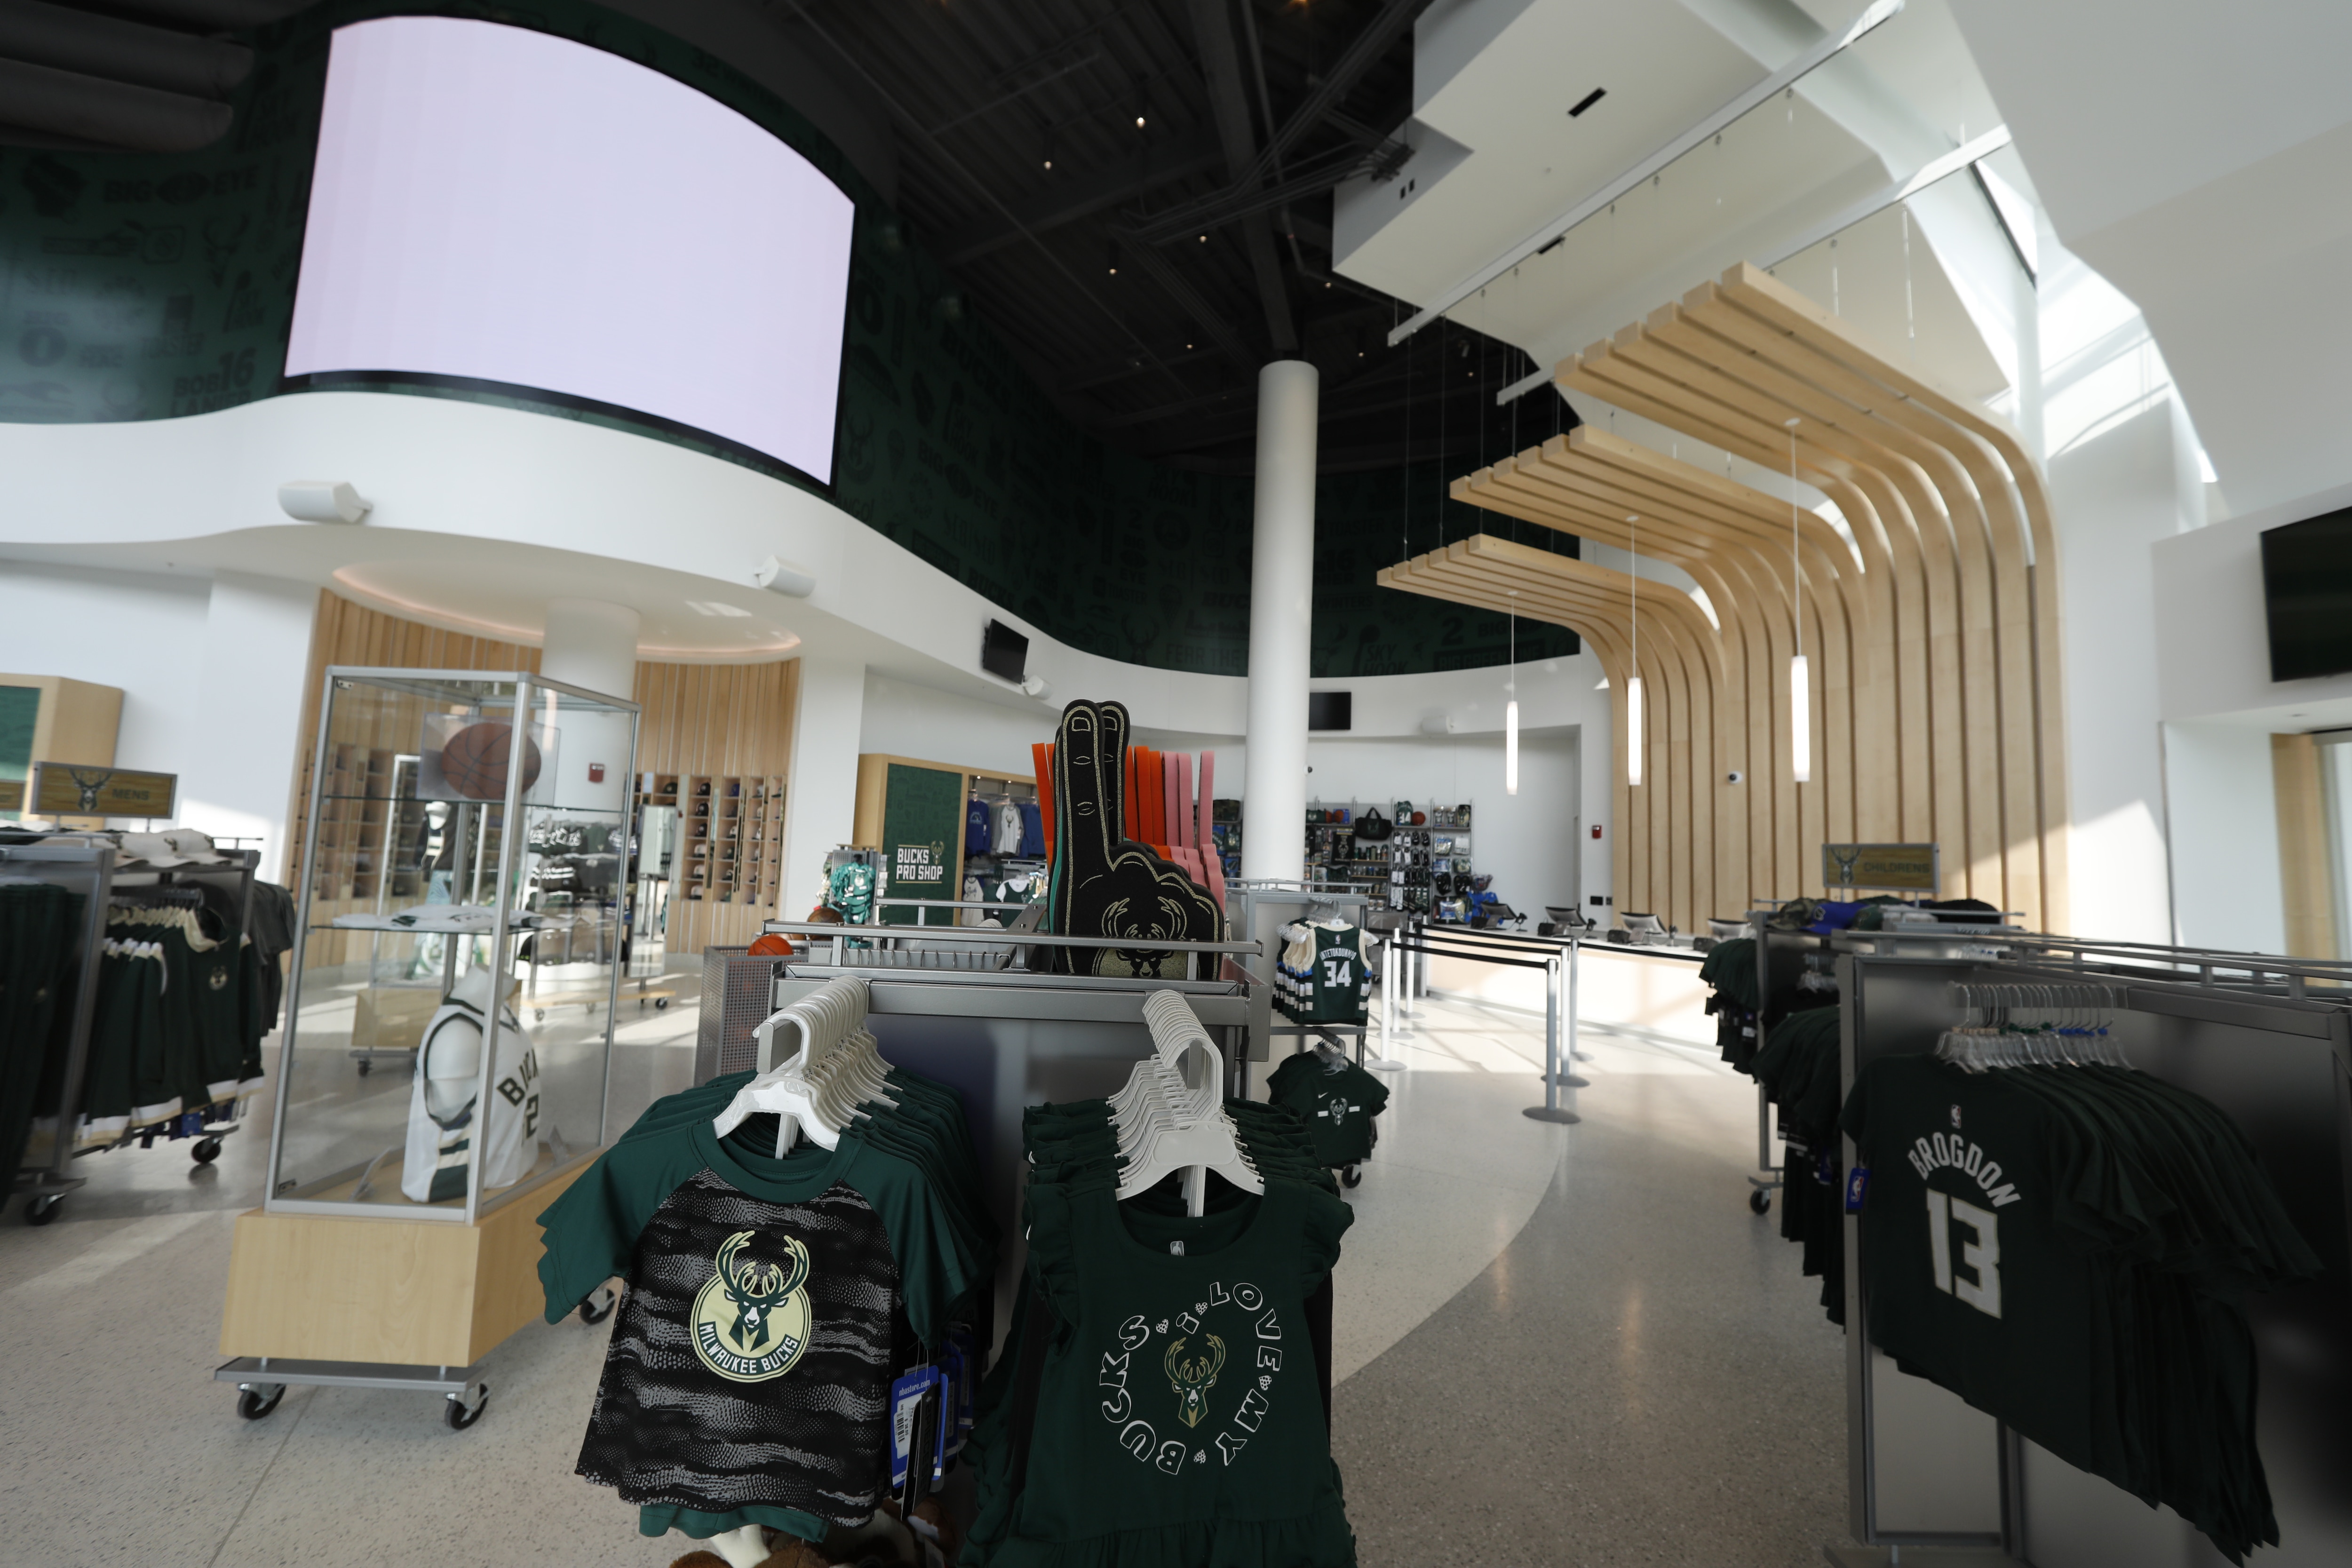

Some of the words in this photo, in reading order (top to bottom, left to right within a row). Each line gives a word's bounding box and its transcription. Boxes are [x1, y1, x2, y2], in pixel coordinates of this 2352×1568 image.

[835, 492, 875, 523] ANGO!
[1201, 591, 1250, 610] BUC
[112, 788, 151, 802] MENS
[897, 848, 929, 864] BUCKS
[1863, 861, 1931, 874] CHILDRENS
[896, 865, 916, 880] PRO
[918, 865, 943, 880] SHOP
[1323, 961, 1352, 987] 34
[1907, 1131, 2022, 1208] BROGDON
[1926, 1187, 2002, 1320] 13
[1209, 1281, 1282, 1371] LOVE
[699, 1323, 757, 1374] MILWAUKEE
[760, 1336, 799, 1372] BUCKS
[898, 1378, 931, 1397] nbastore.com
[1099, 1315, 1186, 1475] BUCKS
[1215, 1388, 1269, 1466] MY
